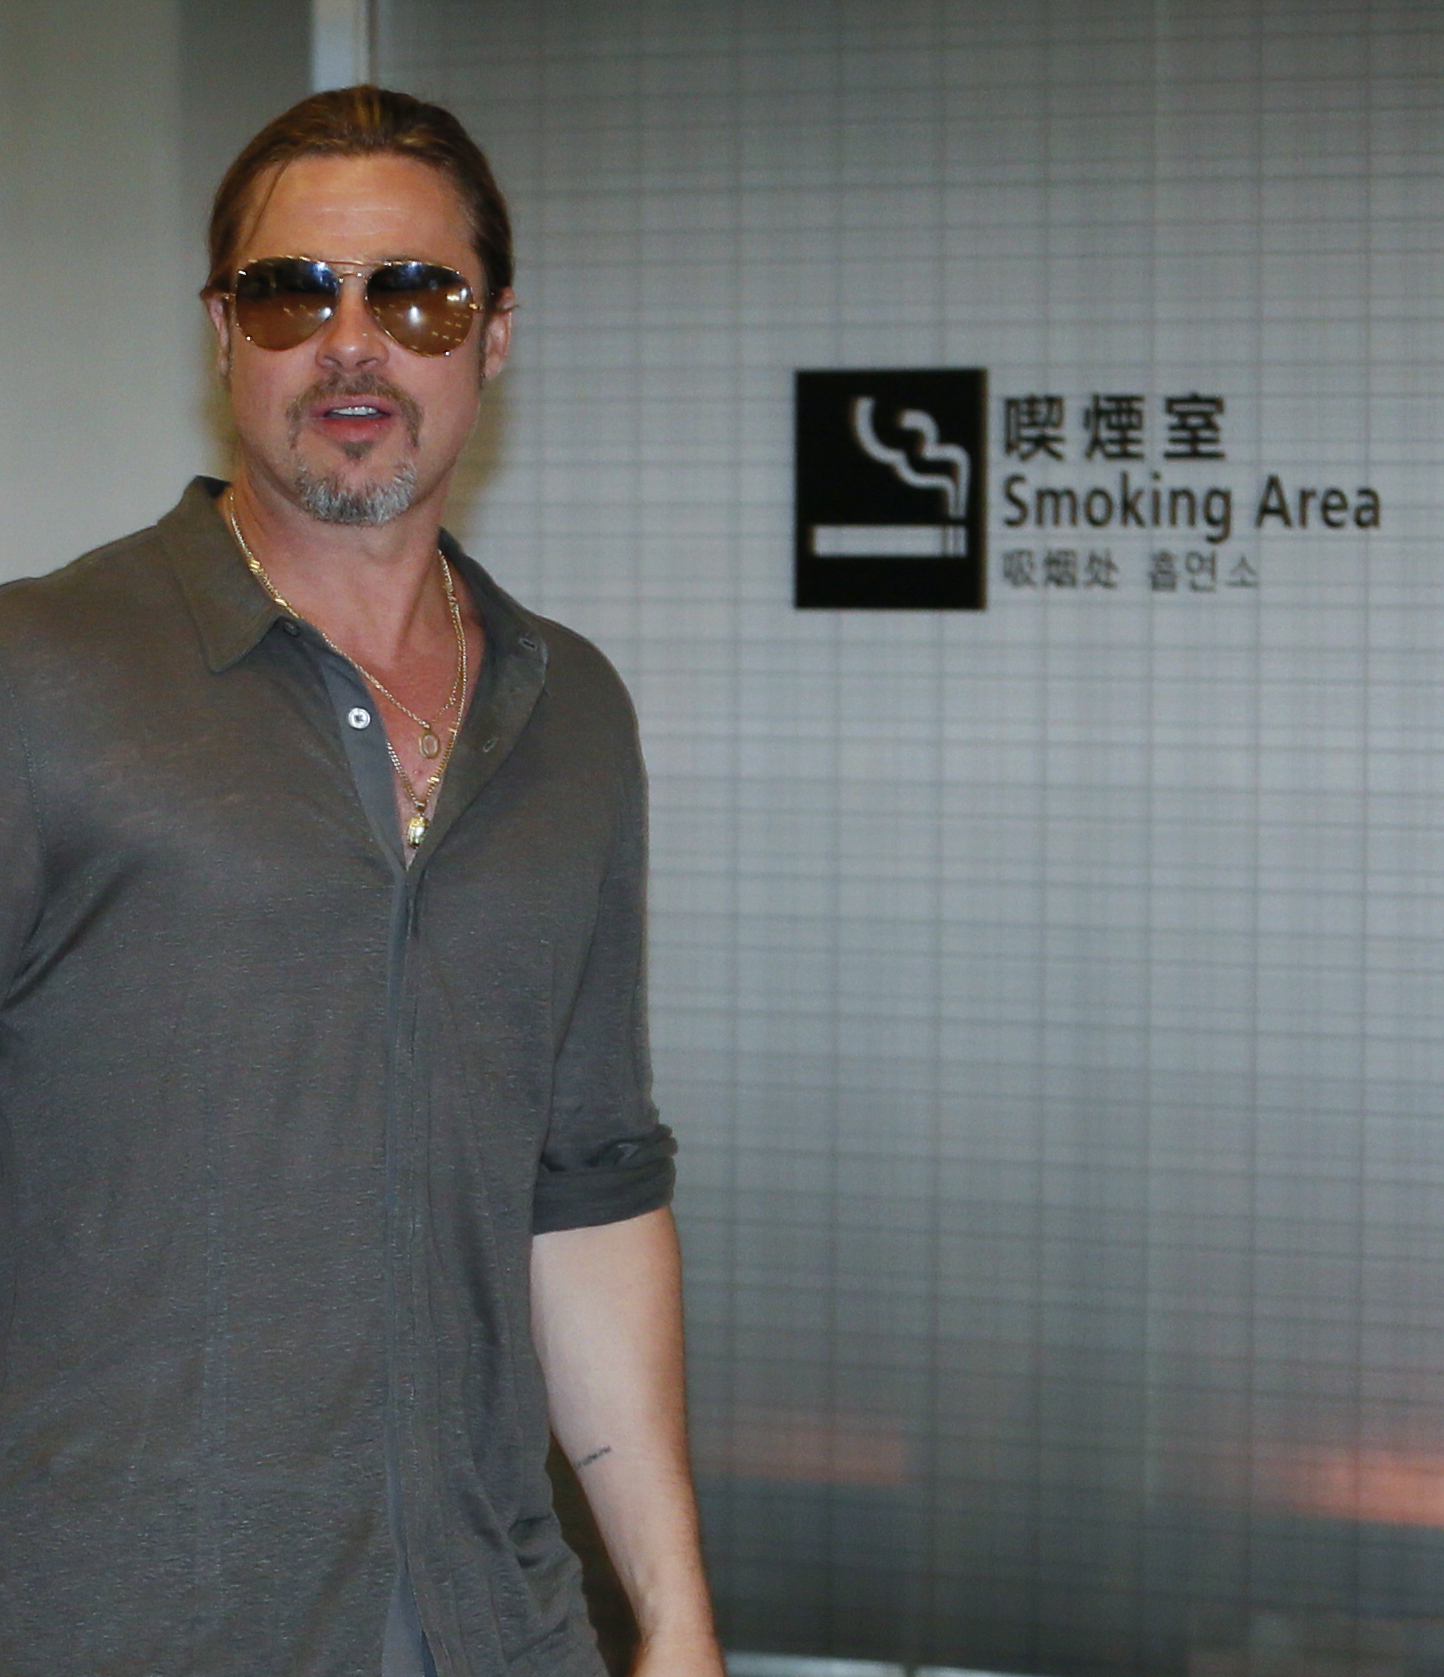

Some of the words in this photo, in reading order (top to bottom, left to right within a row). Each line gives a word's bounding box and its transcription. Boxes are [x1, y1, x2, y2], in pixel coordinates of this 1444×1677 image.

[1003, 392, 1225, 463] 喫煙室
[1002, 471, 1232, 545] Smoking
[1254, 474, 1381, 530] Area
[1002, 549, 1118, 589] 吸烟处
[1148, 550, 1259, 592] 흡연소
